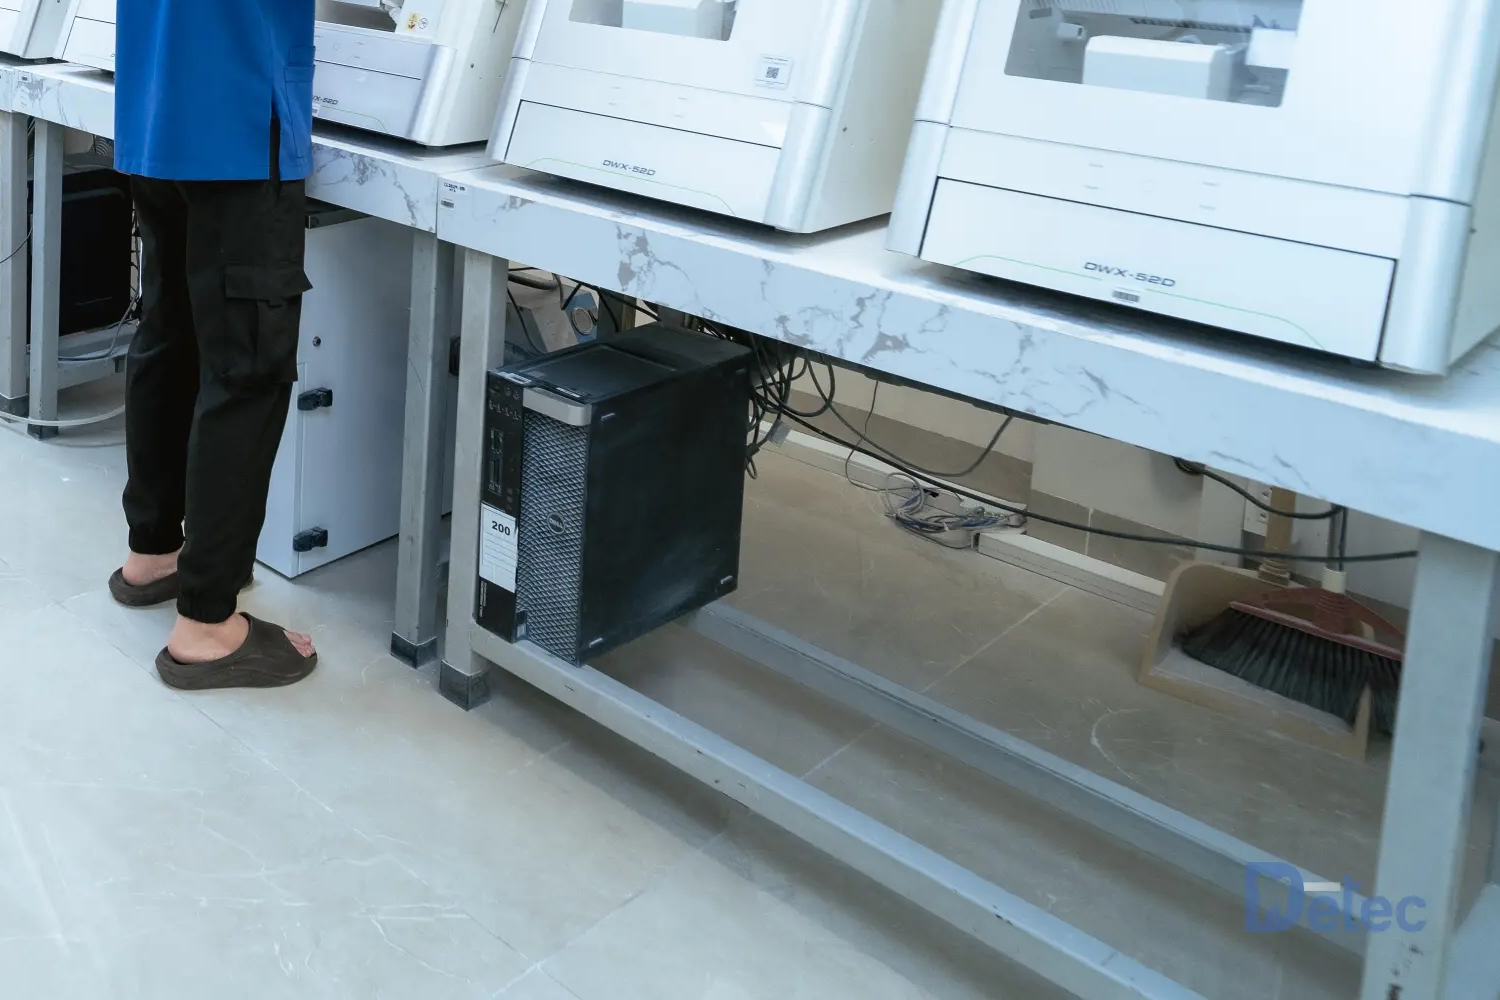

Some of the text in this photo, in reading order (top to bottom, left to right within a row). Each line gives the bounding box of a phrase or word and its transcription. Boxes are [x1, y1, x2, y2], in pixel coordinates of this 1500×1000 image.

[312, 95, 339, 106] X-52D
[602, 159, 656, 176] DWX-52D
[1084, 261, 1177, 287] DWX-52D
[491, 520, 511, 536] 200
